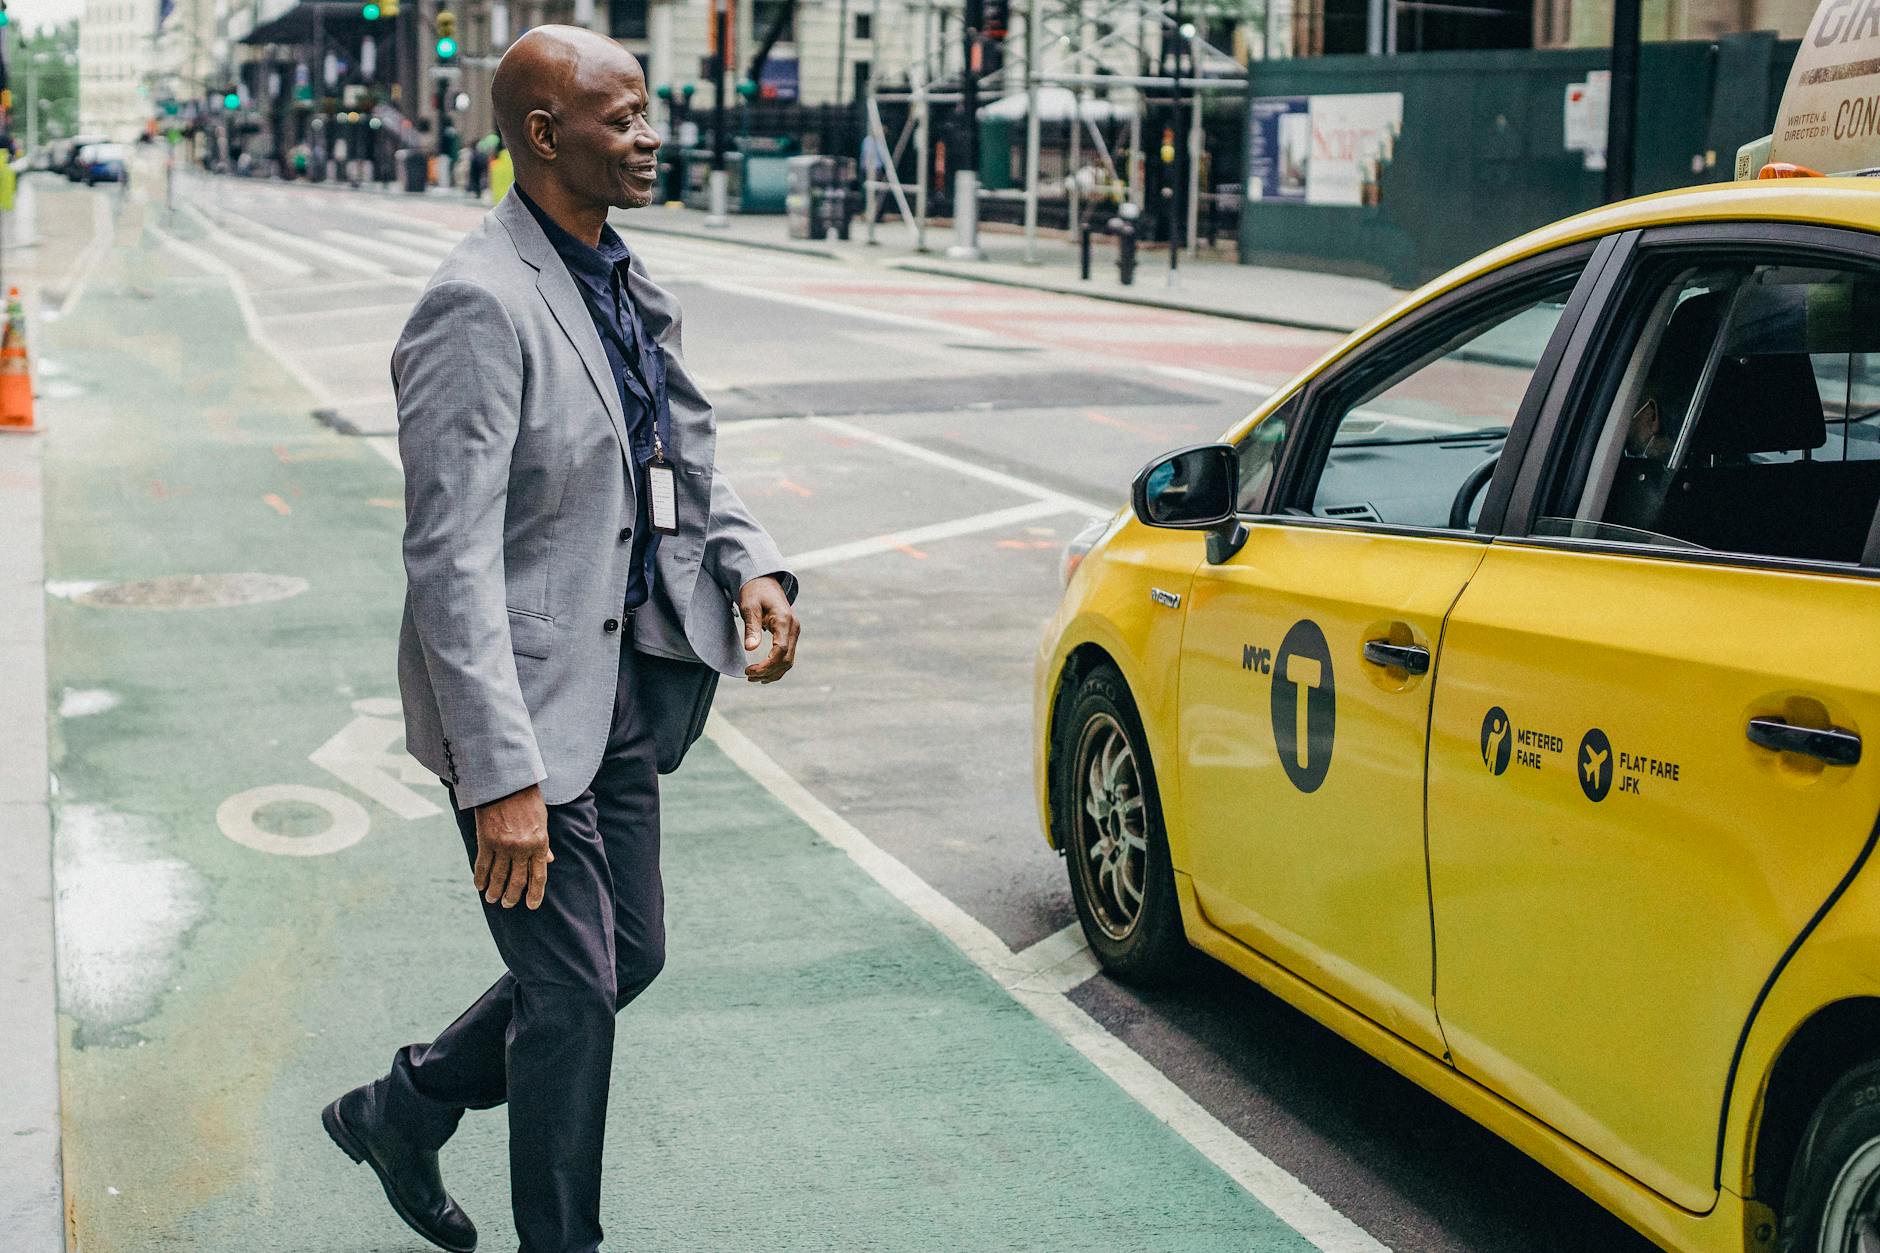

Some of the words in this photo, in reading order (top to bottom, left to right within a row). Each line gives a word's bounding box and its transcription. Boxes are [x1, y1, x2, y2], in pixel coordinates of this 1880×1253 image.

[1788, 113, 1819, 127] WRITTEN
[1821, 112, 1827, 122] &
[1834, 94, 1880, 140] CON
[1784, 127, 1820, 141] DIRECTED
[1820, 125, 1831, 137] BY
[1242, 643, 1271, 675] NYC
[1286, 653, 1322, 770] T
[1517, 728, 1564, 754] METERED
[1516, 750, 1542, 770] FARE
[1619, 752, 1648, 773] FLAT
[1650, 759, 1680, 781] FARE
[1619, 775, 1640, 795] JFK
